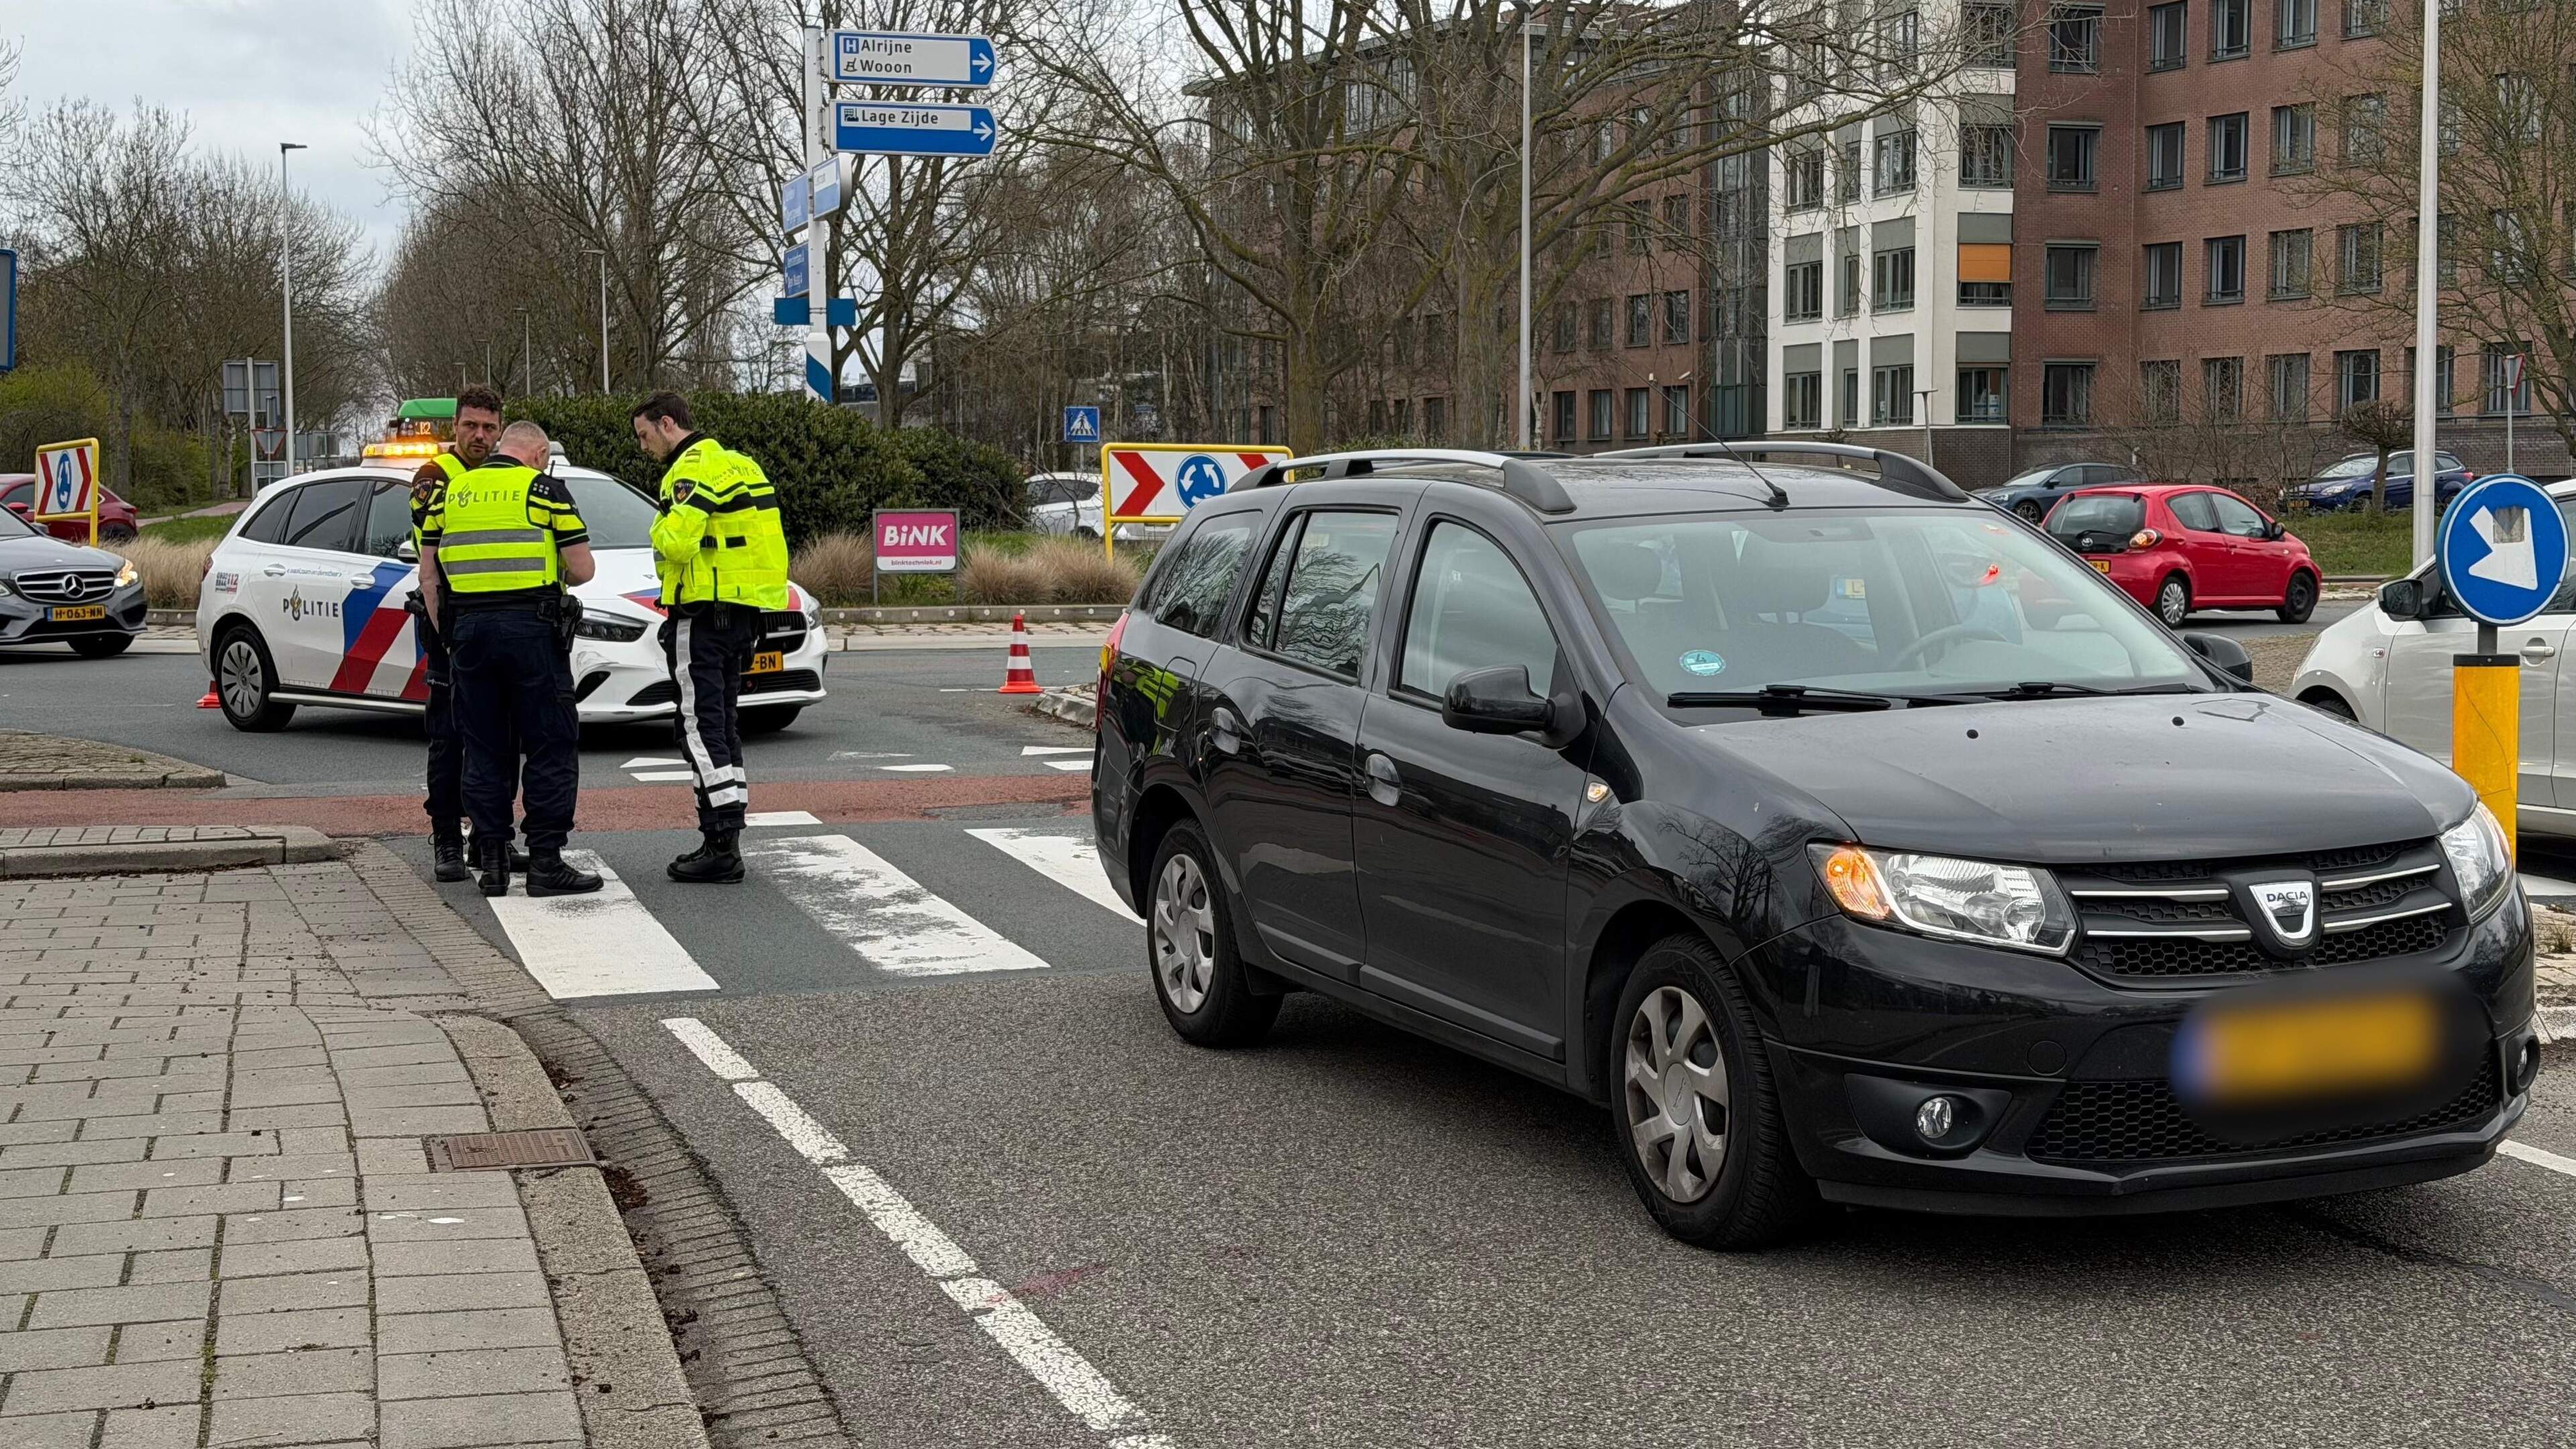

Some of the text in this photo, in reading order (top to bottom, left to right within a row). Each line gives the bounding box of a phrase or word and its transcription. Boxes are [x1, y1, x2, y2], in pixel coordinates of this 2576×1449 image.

[861, 39, 912, 56] Alrijne
[859, 59, 912, 74] Wooon
[861, 109, 939, 127] Lage Zijde
[448, 487, 521, 508] POLITIE
[883, 525, 949, 547] BiNK
[891, 559, 943, 567] binktechniek.nl
[283, 592, 339, 622] POLITIE
[2265, 890, 2308, 903] DACIA
